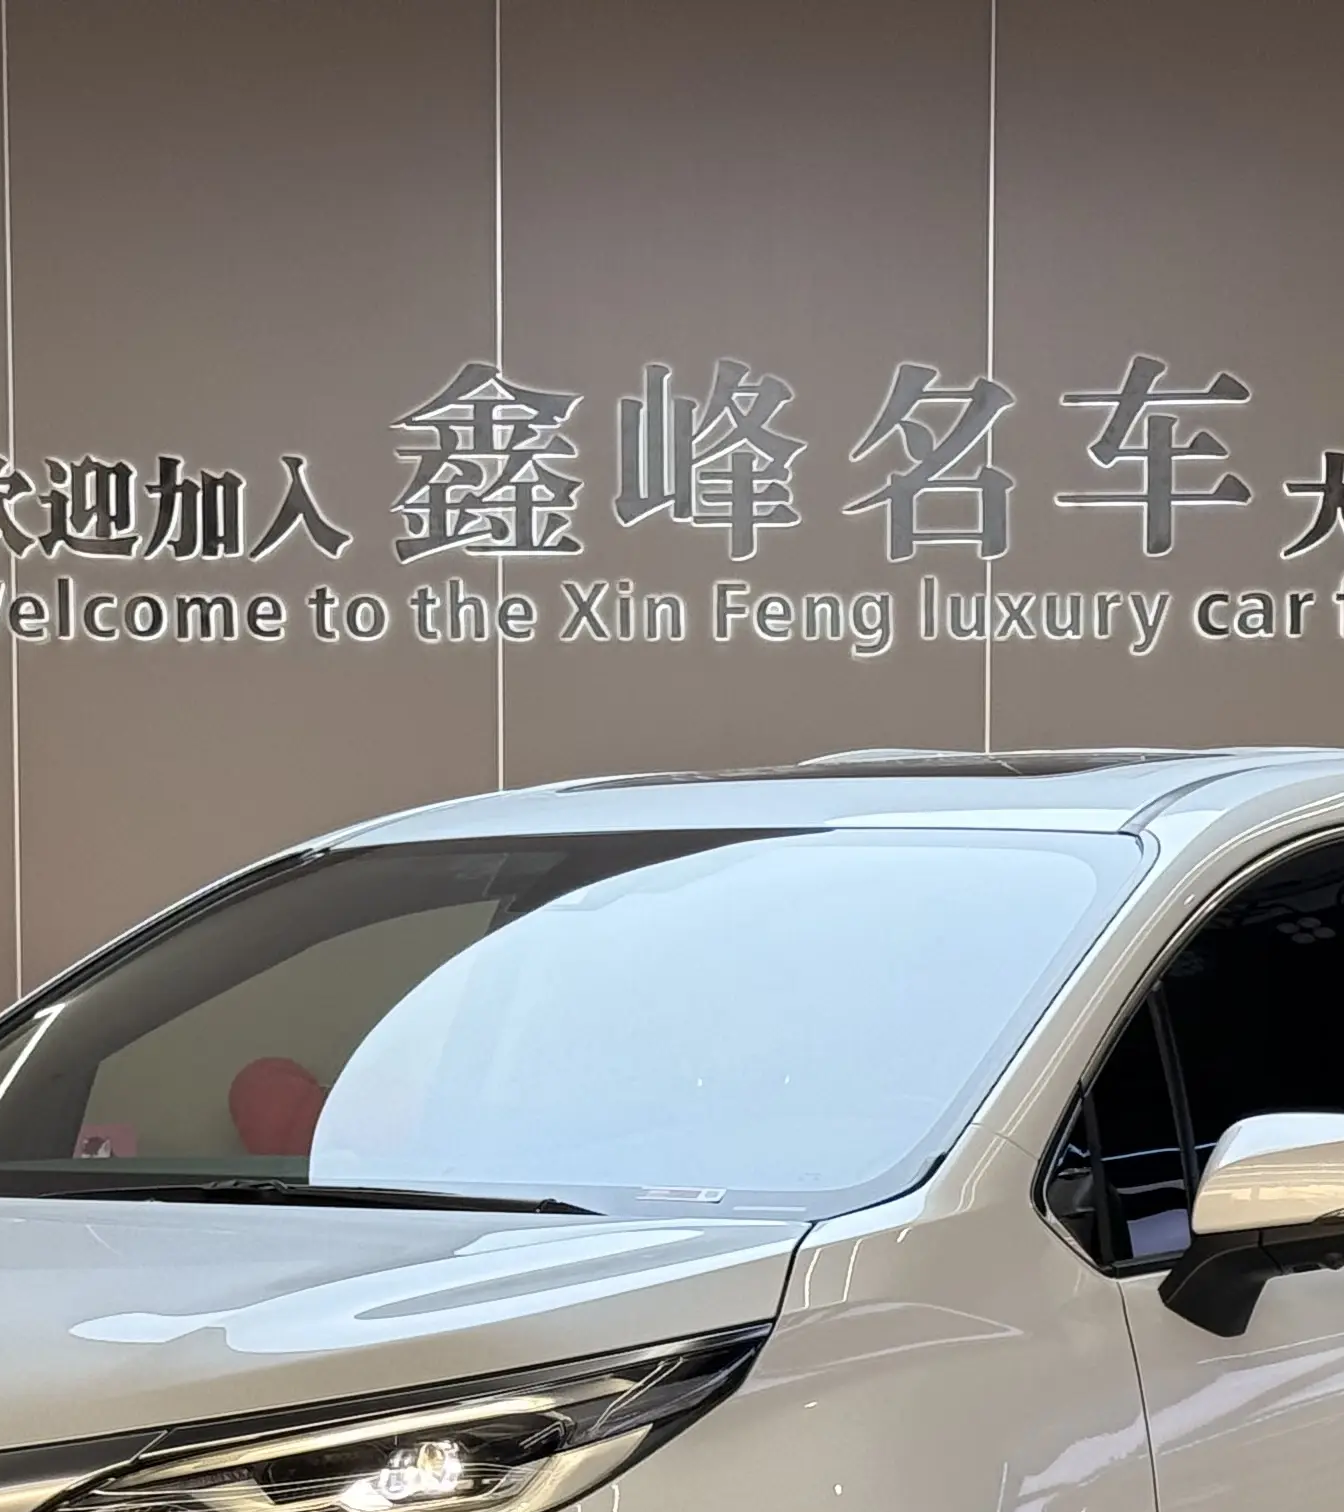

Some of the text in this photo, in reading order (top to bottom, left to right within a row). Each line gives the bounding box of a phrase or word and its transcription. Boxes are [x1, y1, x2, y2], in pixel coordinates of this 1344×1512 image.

[391, 355, 1253, 563] 鑫峰名车
[306, 583, 387, 643] to
[410, 579, 537, 643] the
[561, 579, 685, 642] Xin
[713, 581, 893, 658] Feng
[920, 576, 1171, 656] luxury
[1198, 586, 1316, 641] car
